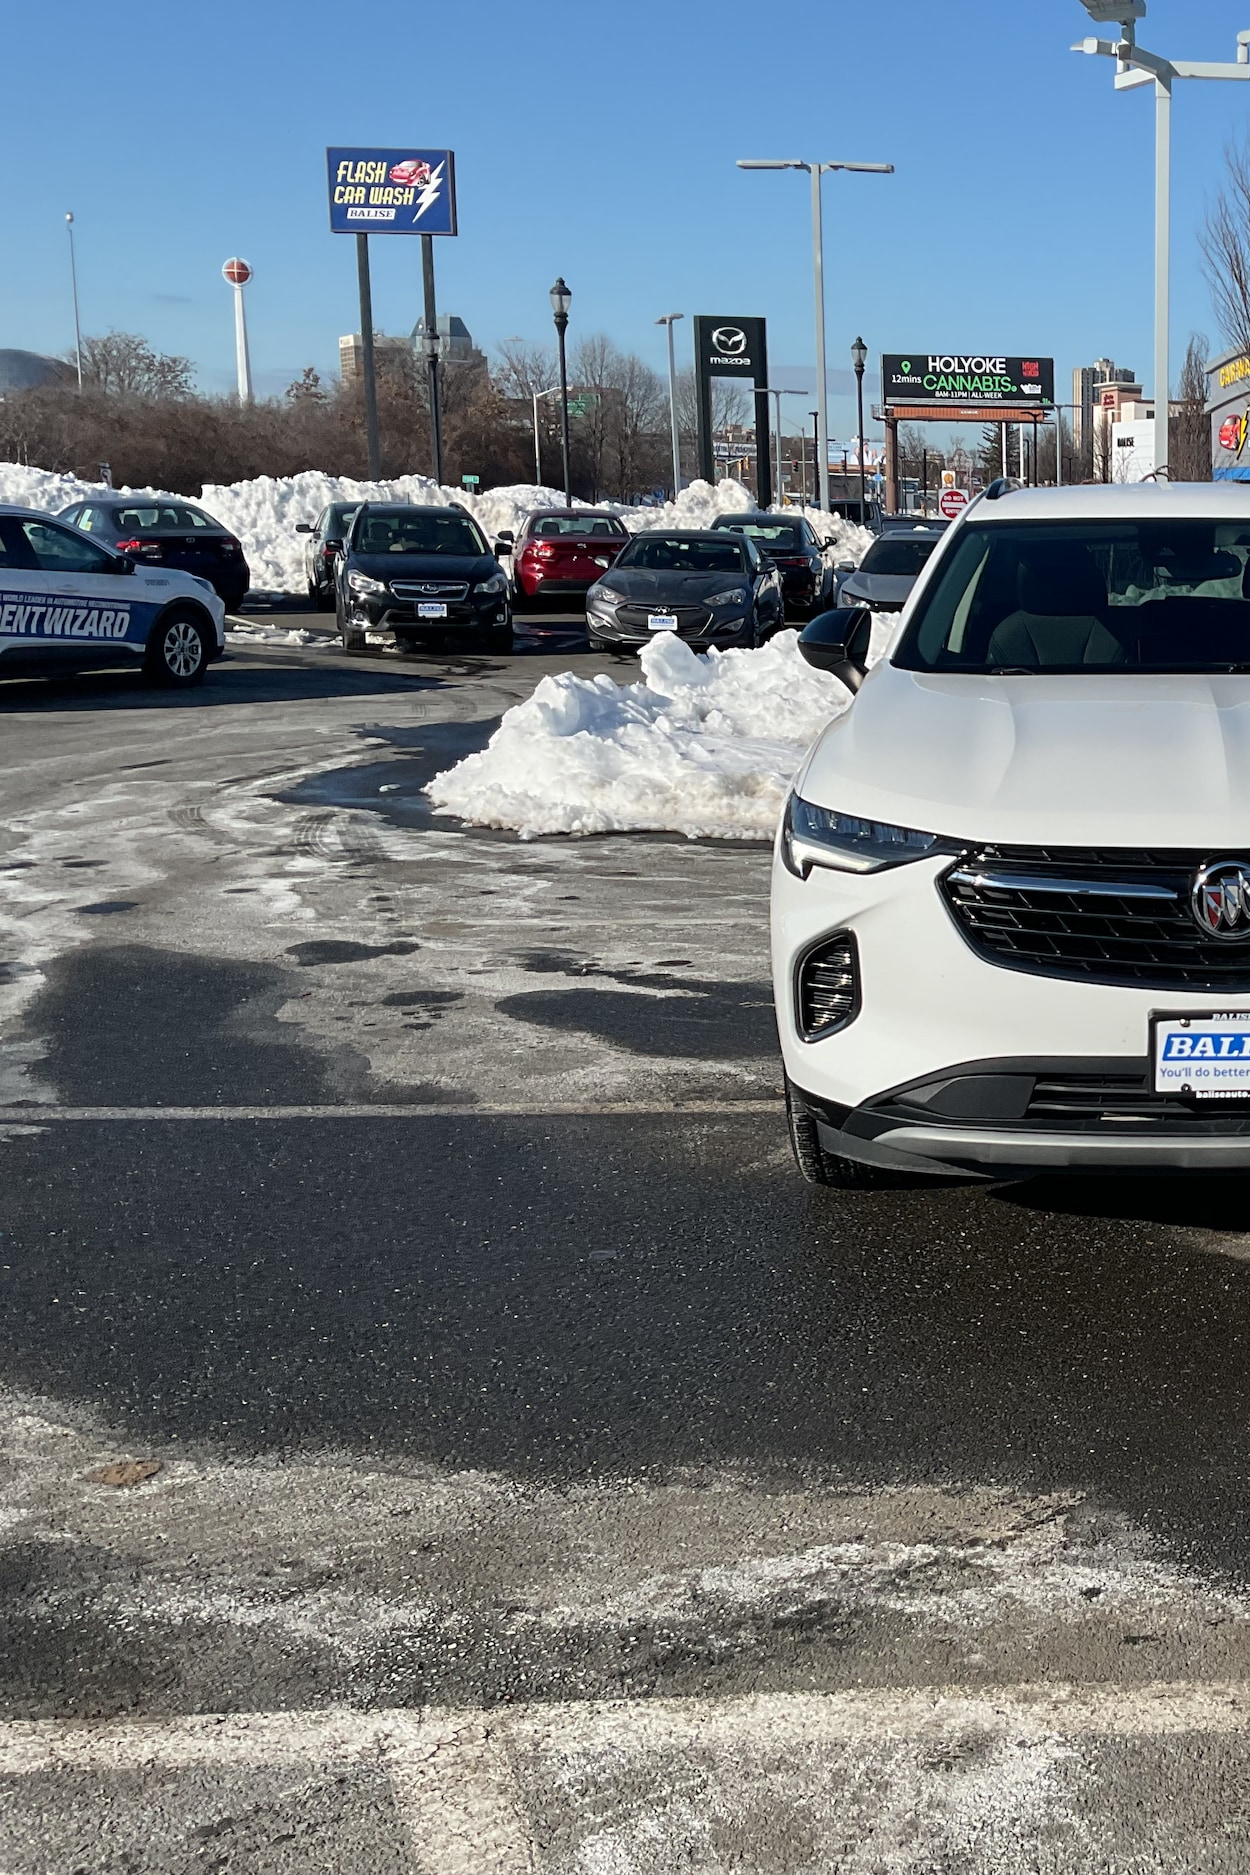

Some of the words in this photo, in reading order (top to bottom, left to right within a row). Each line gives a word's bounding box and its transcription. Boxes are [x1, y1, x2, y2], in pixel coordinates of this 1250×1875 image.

[336, 160, 388, 183] FLASH
[333, 186, 366, 205] CAR
[368, 187, 415, 205] WASH
[349, 209, 394, 218] BALISE
[709, 356, 751, 366] mazda
[928, 356, 1007, 375] HOLYOKE
[891, 374, 922, 384] 12mins
[1219, 363, 1237, 388] CAR
[923, 374, 1018, 393] CANNABIS.
[934, 390, 969, 399] 8AM-11PM
[971, 391, 1003, 400] ALL-WEEK
[1160, 1067, 1192, 1078] You'll
[1195, 1067, 1210, 1077] do
[1213, 1067, 1250, 1077] better
